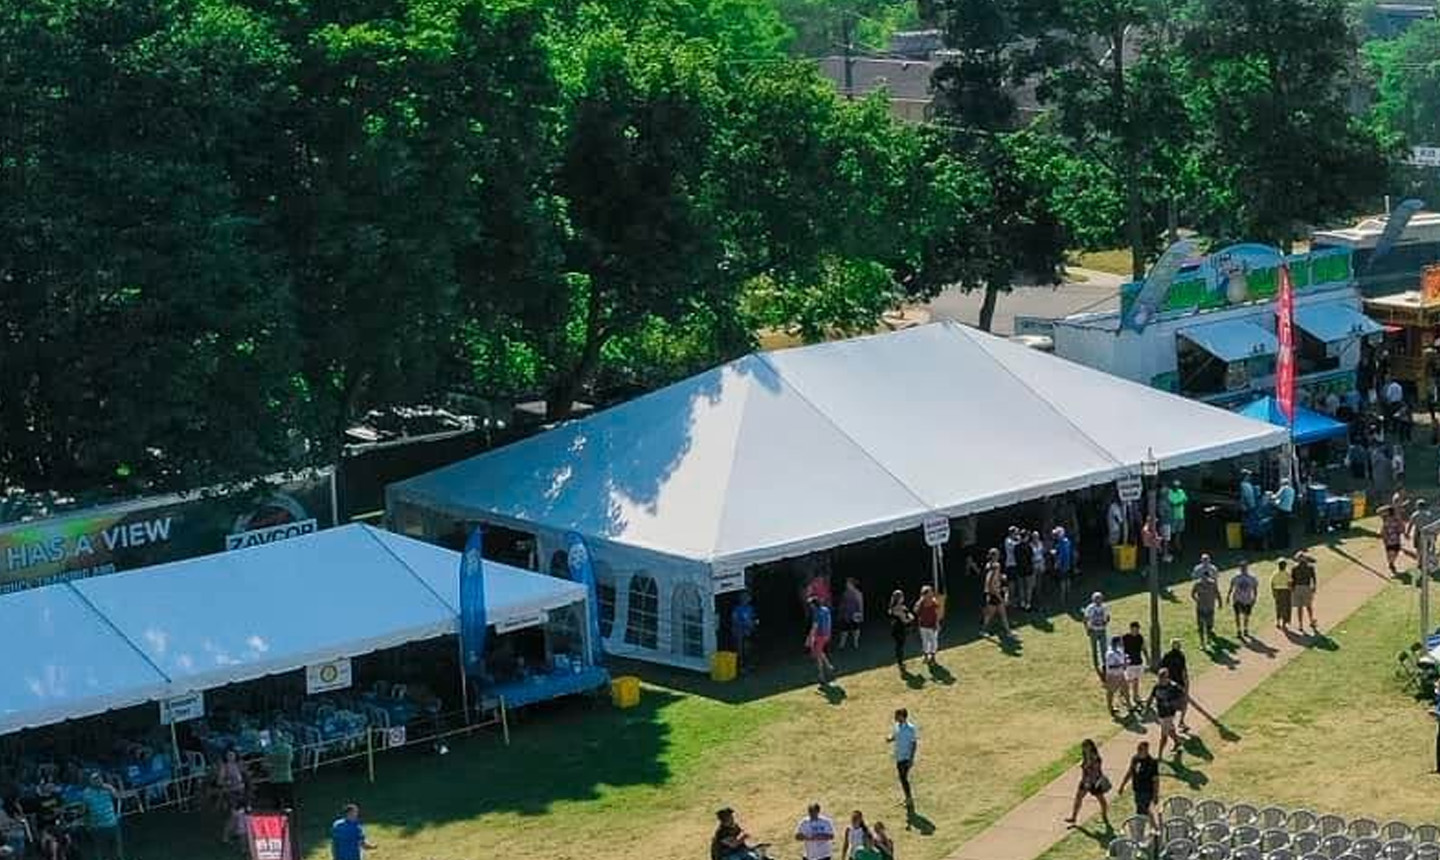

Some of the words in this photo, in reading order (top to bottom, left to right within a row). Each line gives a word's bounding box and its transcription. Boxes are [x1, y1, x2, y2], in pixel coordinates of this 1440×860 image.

[7, 537, 66, 571] HAS
[74, 536, 95, 556] A
[102, 517, 172, 550] VIEW
